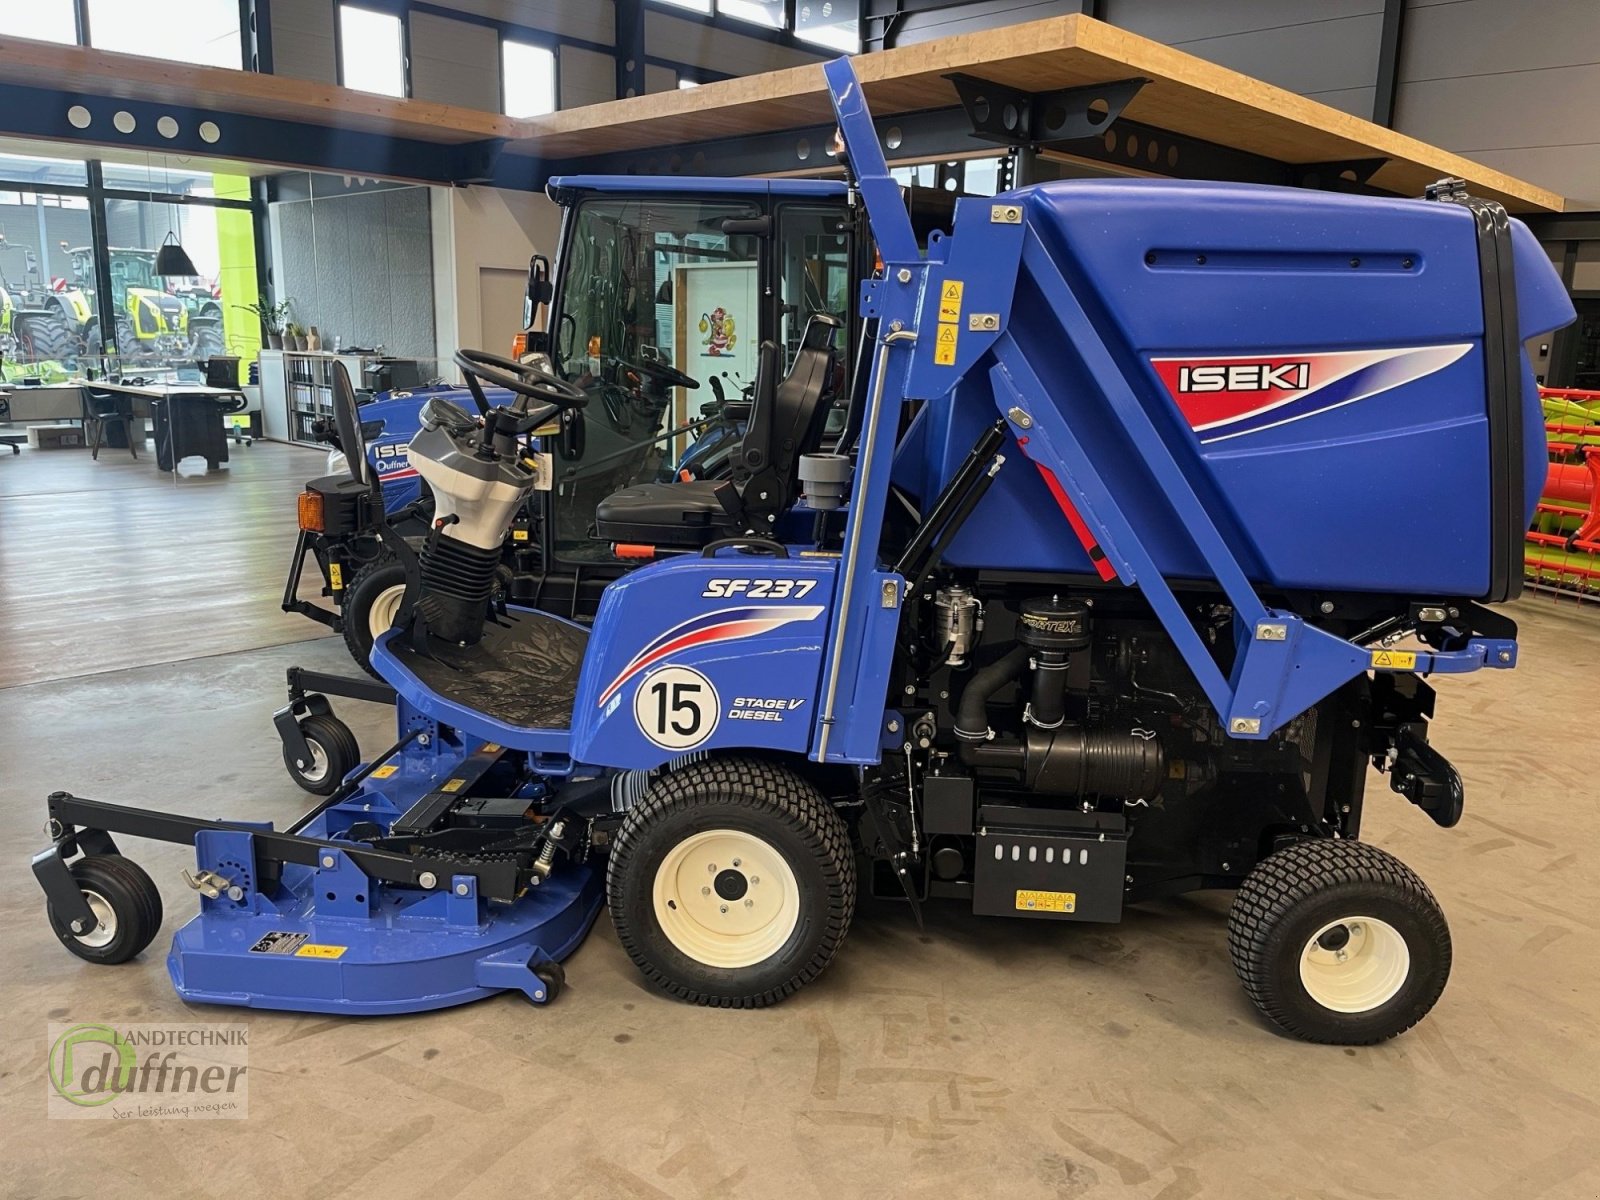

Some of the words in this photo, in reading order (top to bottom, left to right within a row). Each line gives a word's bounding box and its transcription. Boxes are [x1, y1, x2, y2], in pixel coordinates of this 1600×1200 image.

[1179, 362, 1310, 393] ISEKI
[651, 682, 702, 736] 15
[733, 697, 787, 710] STAGE
[787, 698, 806, 710] V
[727, 709, 783, 722] DIESEL
